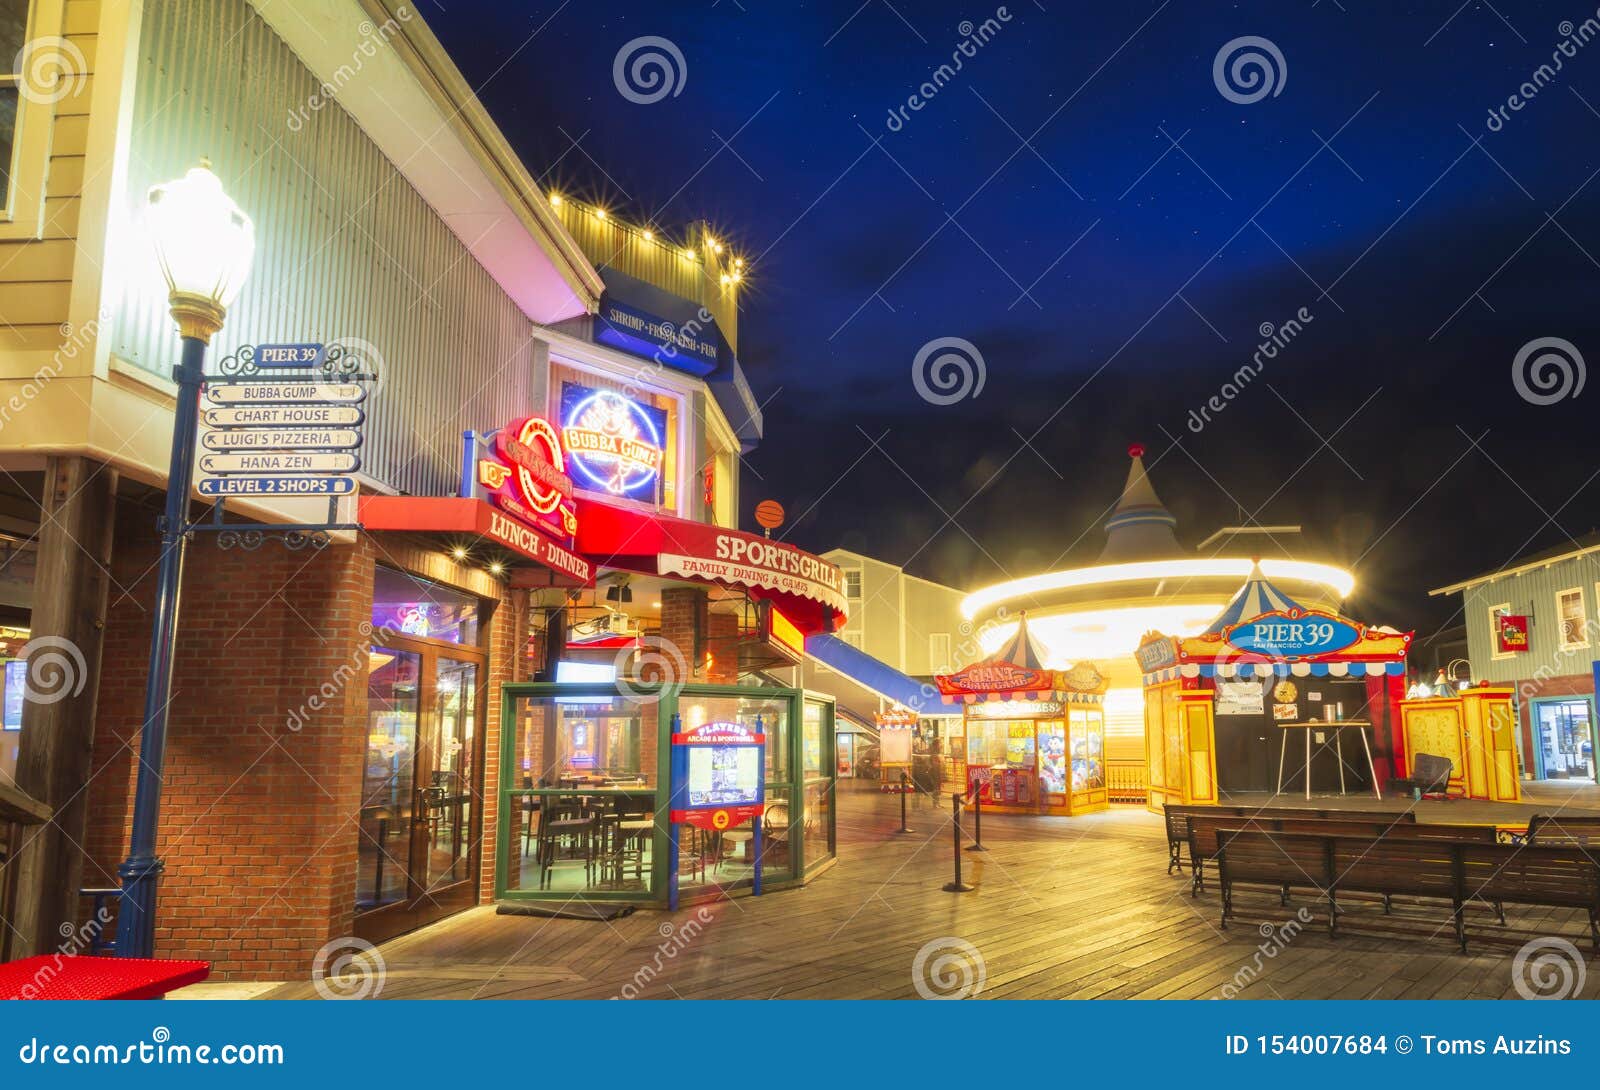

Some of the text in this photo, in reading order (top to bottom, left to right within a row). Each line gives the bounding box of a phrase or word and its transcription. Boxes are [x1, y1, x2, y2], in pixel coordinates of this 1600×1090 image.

[610, 308, 645, 331] SHRIMP
[700, 342, 717, 359] FUN
[261, 348, 318, 363] PIER 39
[244, 387, 317, 399] BUBBA GUMP
[234, 410, 329, 422] CHART HOUSE
[223, 433, 331, 446] LUIGI'S PIZZERIA
[568, 430, 618, 453] BUBBA
[240, 456, 313, 469] HANA ZEN
[218, 480, 328, 492] LEVEL 2 SHOPS
[490, 512, 540, 555] LUNCH
[547, 542, 589, 580] DINNER
[682, 560, 729, 576] FAMILY
[733, 567, 769, 583] DINING
[772, 577, 779, 585] &
[782, 577, 808, 592] GAMES
[1253, 623, 1335, 646] PIER 39
[968, 666, 1014, 681] GIANT
